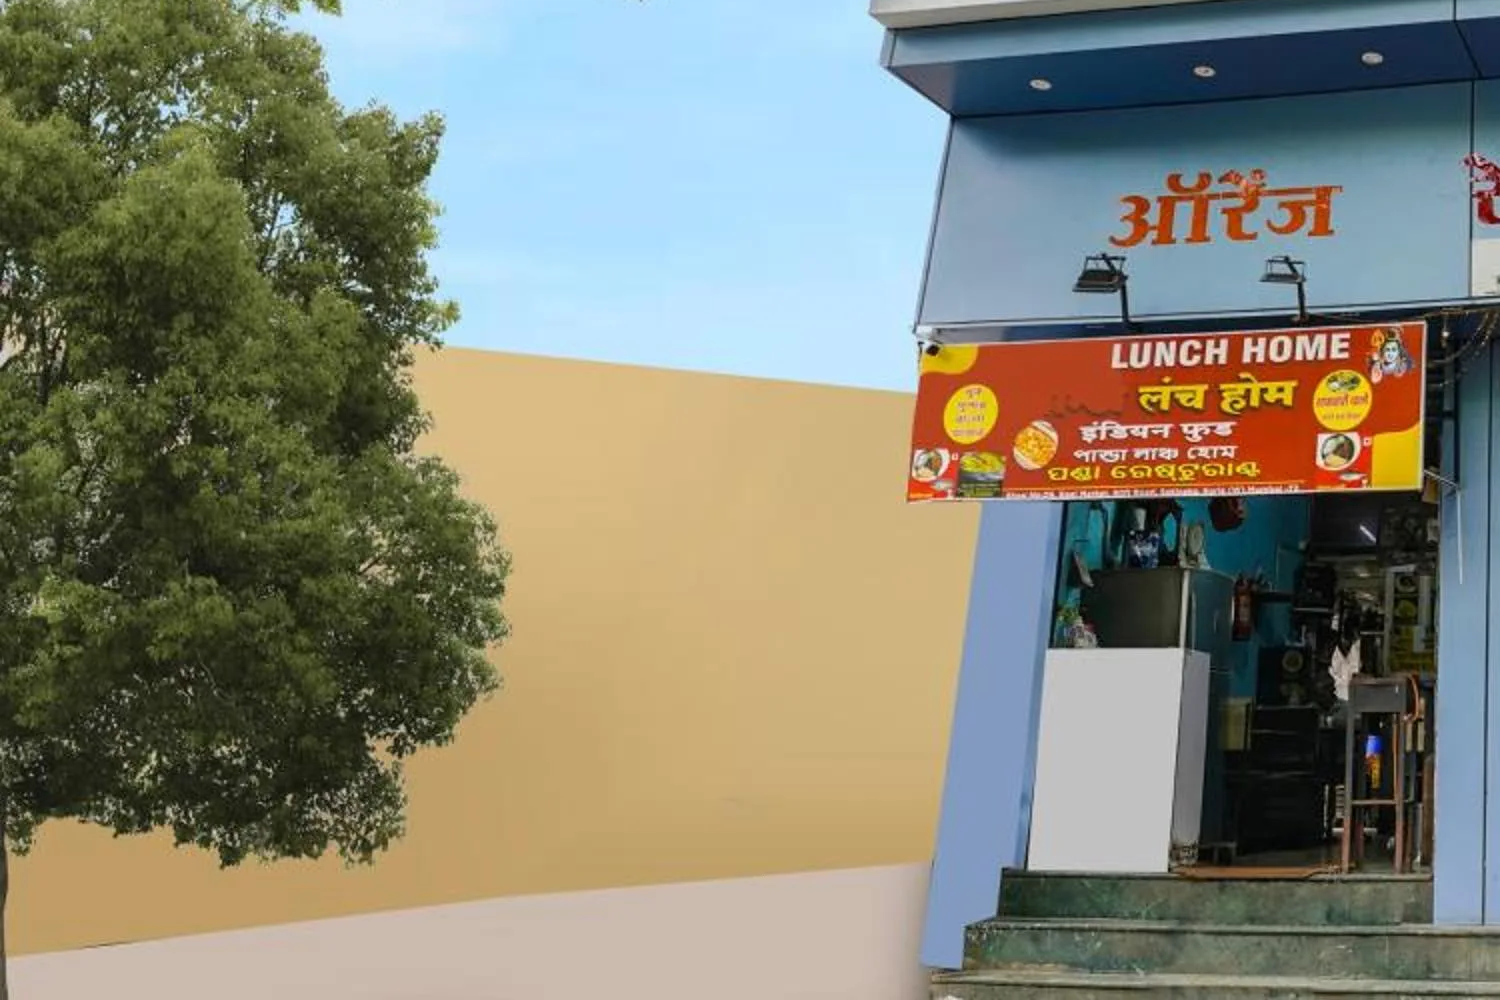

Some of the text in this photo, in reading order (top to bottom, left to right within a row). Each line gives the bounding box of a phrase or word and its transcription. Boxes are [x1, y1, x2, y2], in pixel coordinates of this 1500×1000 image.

[1111, 333, 1351, 370] LUNCH HOME
[1138, 376, 1210, 413] लंच
[1219, 372, 1299, 414] होम
